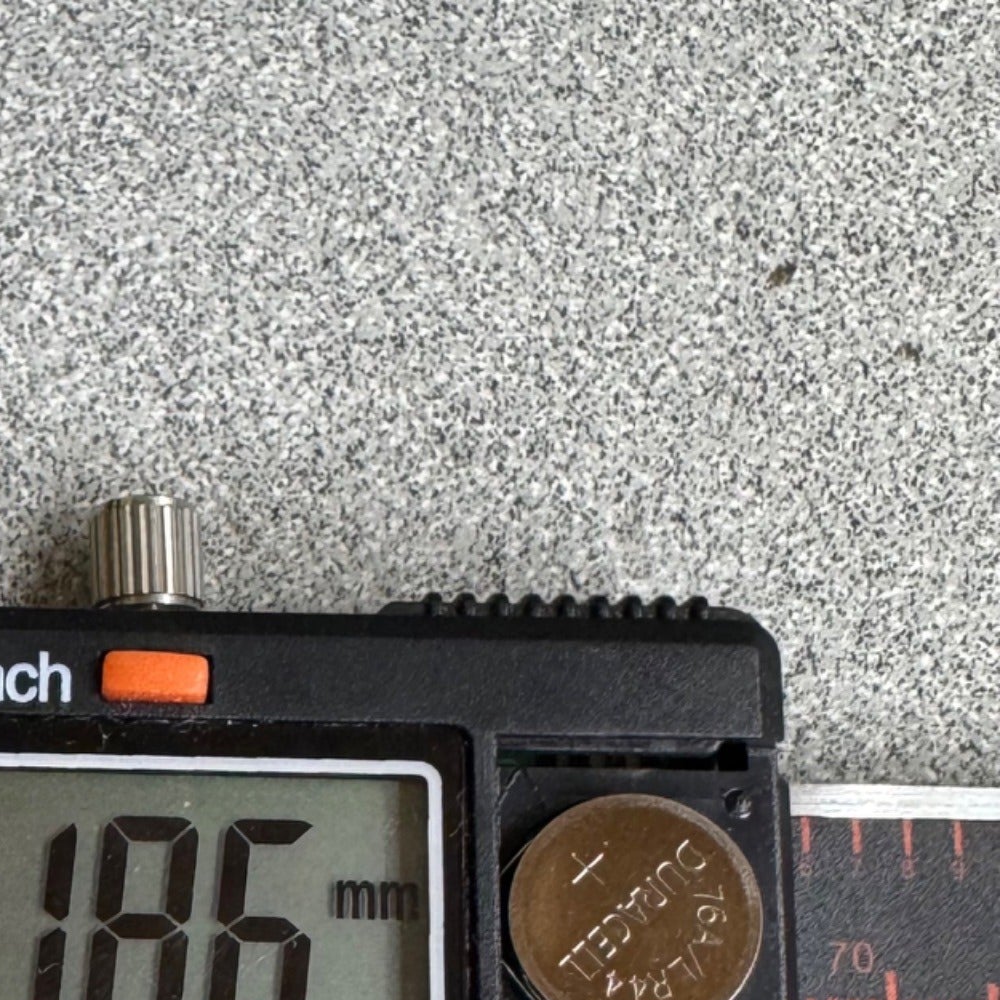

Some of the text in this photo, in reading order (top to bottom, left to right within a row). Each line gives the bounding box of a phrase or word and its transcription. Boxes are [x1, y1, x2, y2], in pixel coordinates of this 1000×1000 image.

[334, 878, 420, 920] mm
[558, 838, 707, 982] DURACELL
[829, 940, 876, 975] 70
